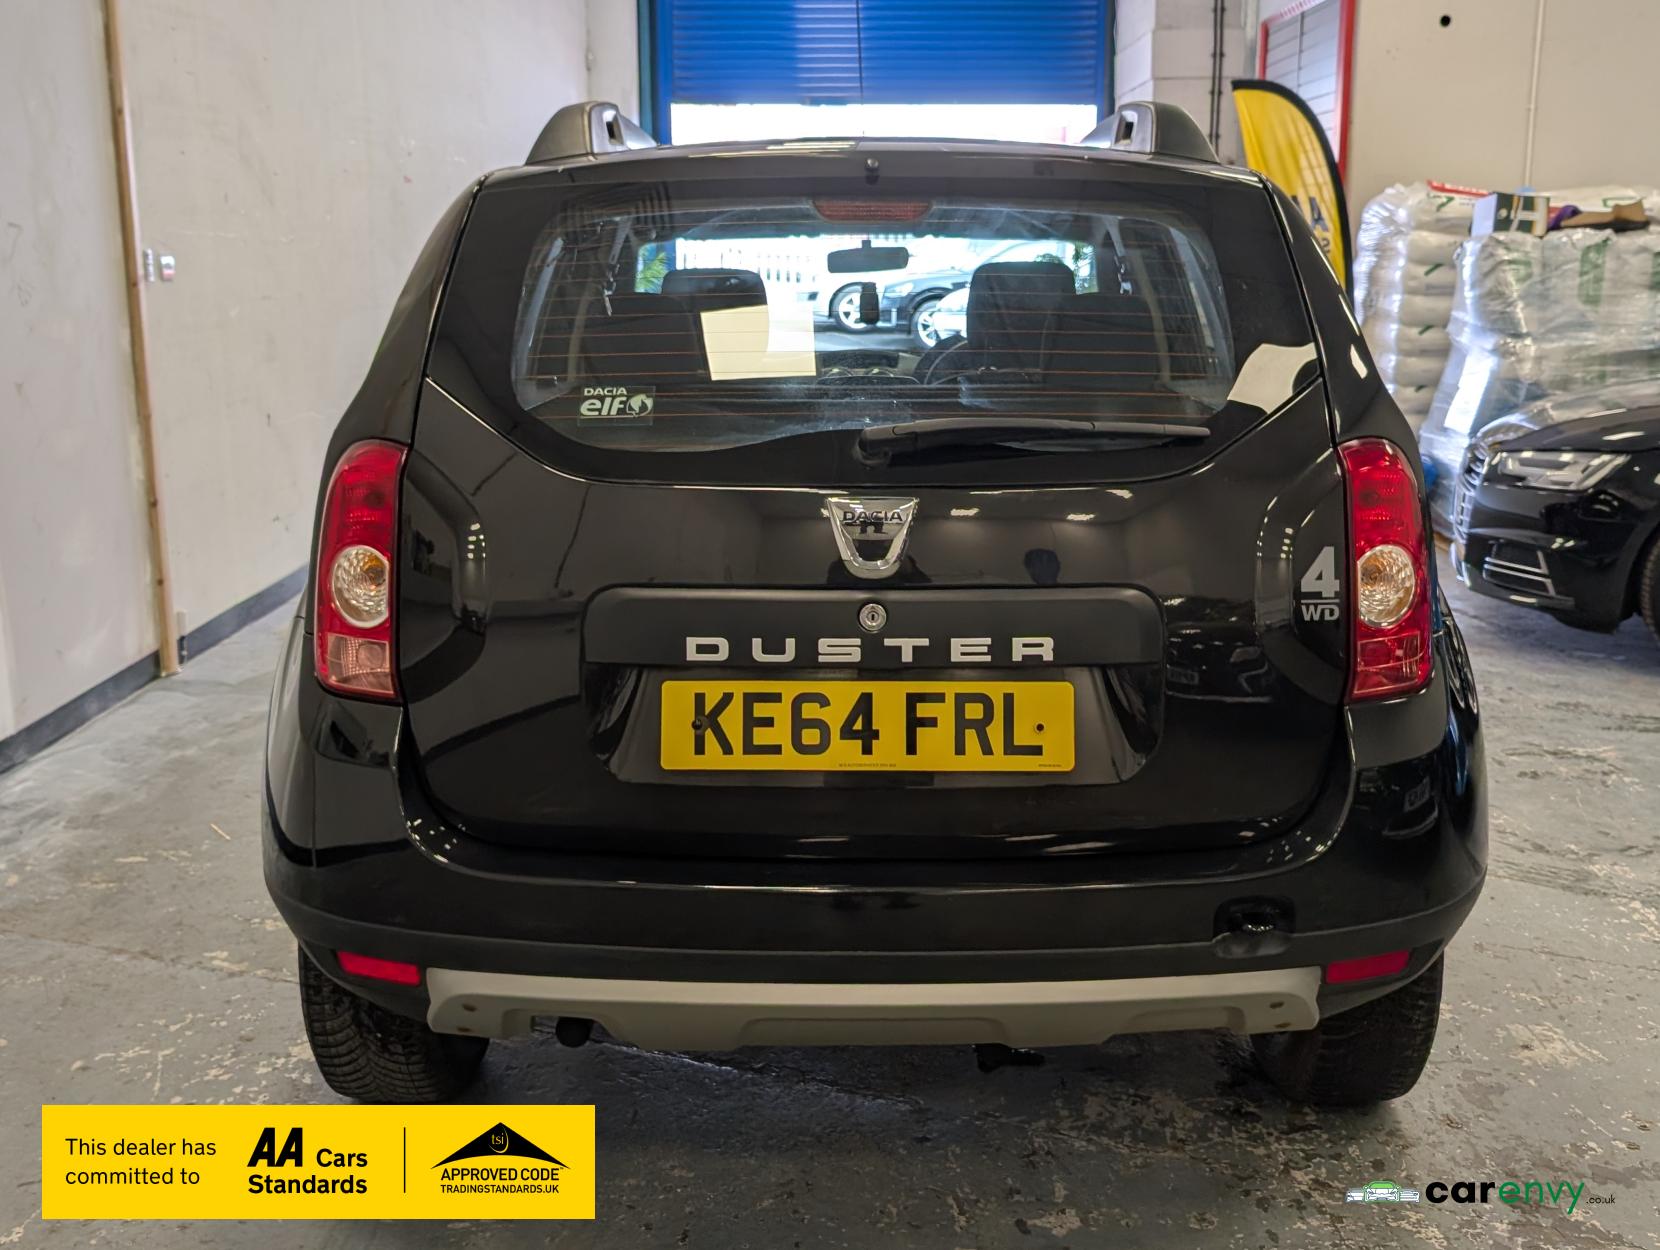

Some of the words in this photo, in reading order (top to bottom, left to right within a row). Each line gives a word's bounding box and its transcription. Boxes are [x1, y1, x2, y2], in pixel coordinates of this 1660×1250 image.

[583, 387, 628, 396] DACIA
[580, 396, 628, 416] elf
[843, 511, 903, 522] DACIA
[1301, 546, 1340, 597] 4
[1301, 604, 1340, 621] WD
[686, 637, 1055, 663] DUSTER
[691, 692, 880, 757] KE64
[905, 692, 1044, 757] FRL
